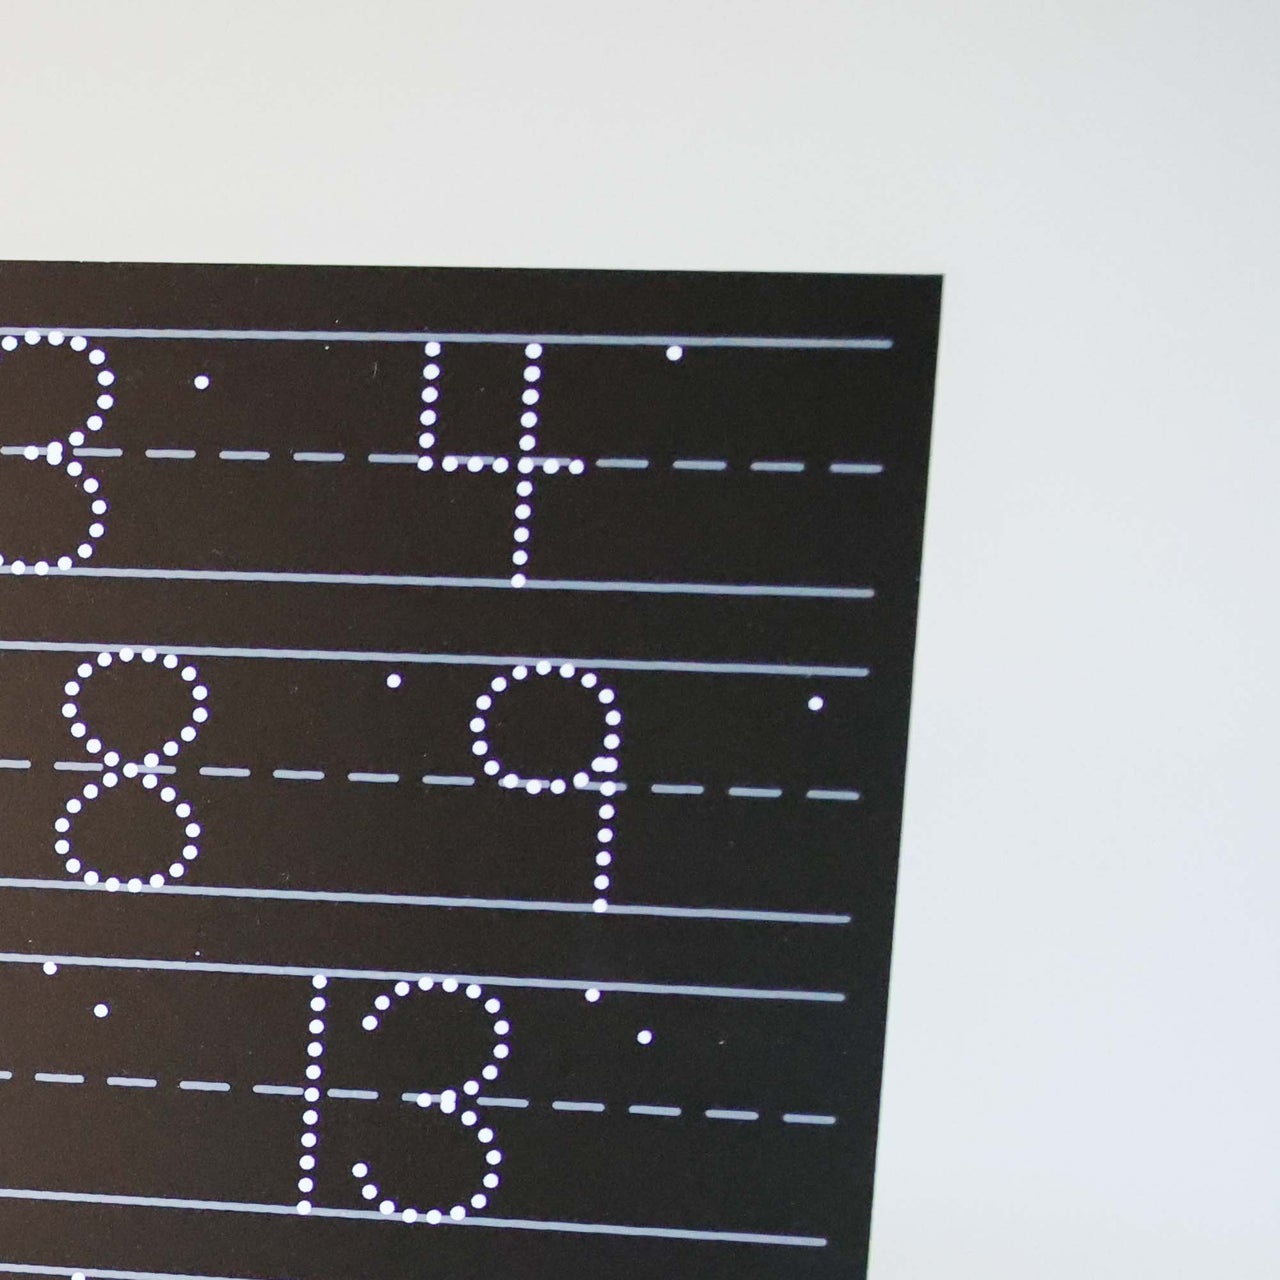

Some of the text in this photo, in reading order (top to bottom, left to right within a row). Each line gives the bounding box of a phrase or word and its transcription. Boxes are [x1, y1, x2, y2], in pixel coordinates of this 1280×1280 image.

[418, 342, 584, 588] 4
[54, 648, 208, 893] 8
[469, 660, 620, 913] 9
[296, 975, 510, 1224] 13
